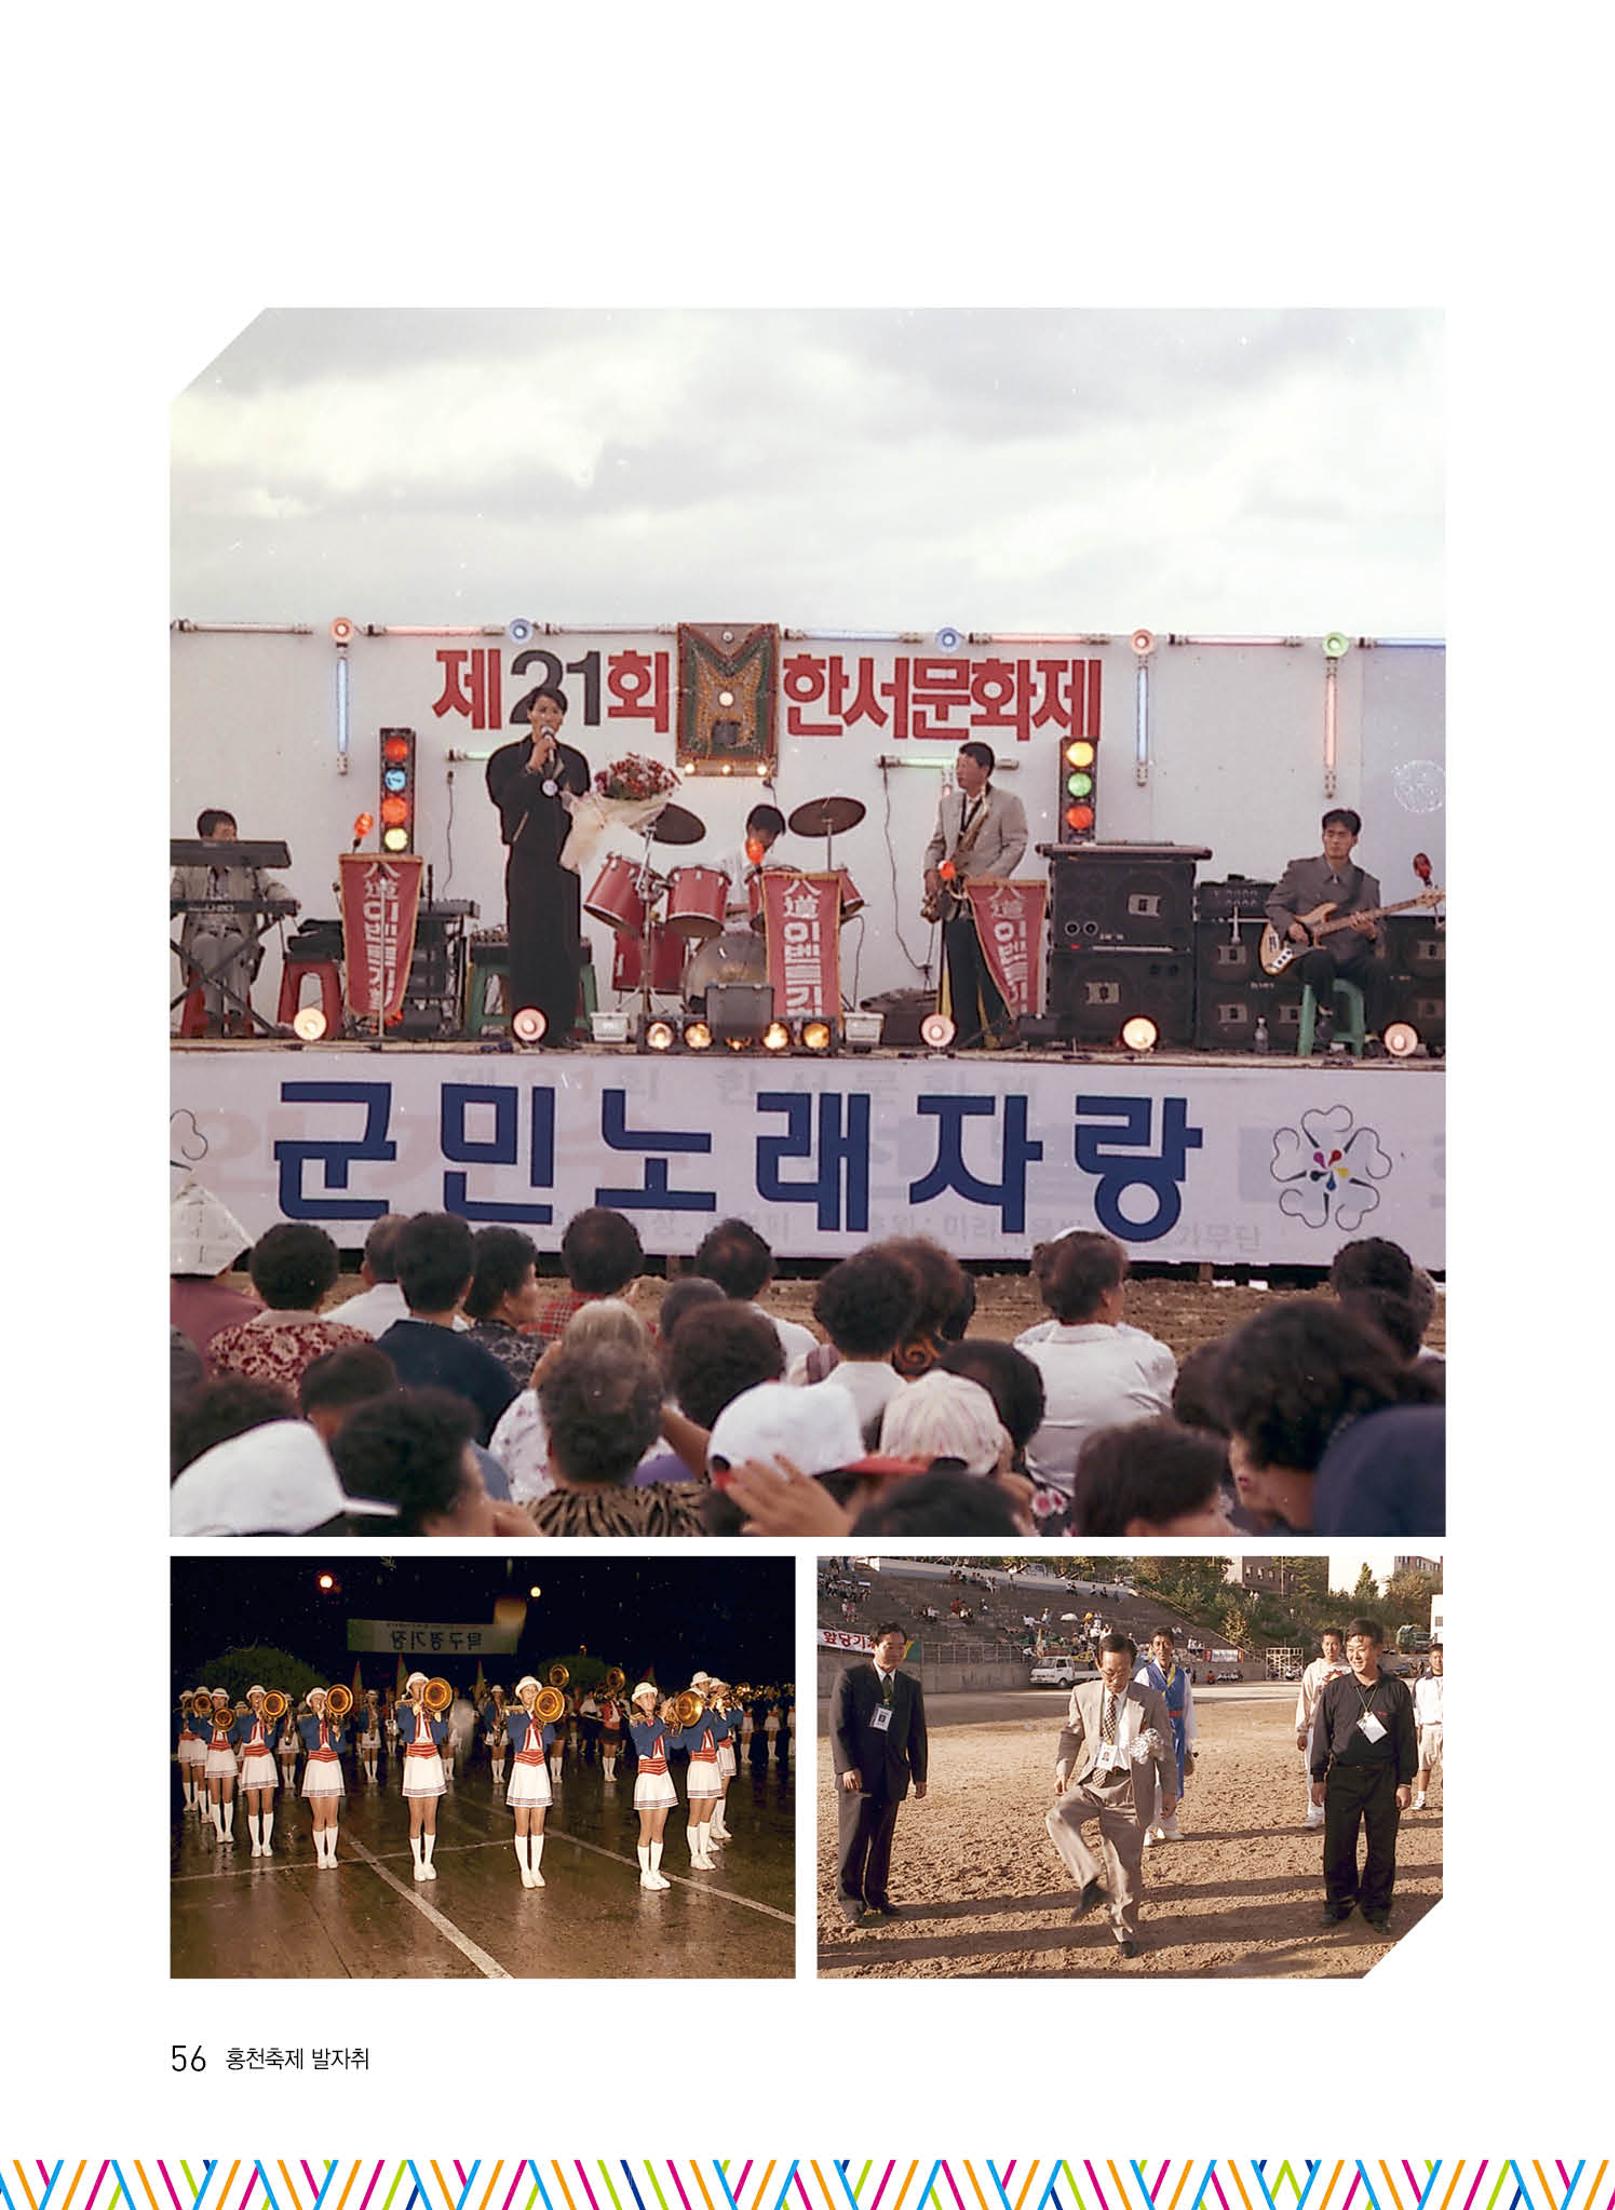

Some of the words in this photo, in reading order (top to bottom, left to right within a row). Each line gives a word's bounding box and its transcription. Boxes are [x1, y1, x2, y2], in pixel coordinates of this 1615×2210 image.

[432, 647, 671, 734] 제21회
[781, 653, 1102, 741] 한서문화제
[273, 1081, 1204, 1243] 군민노래자랑
